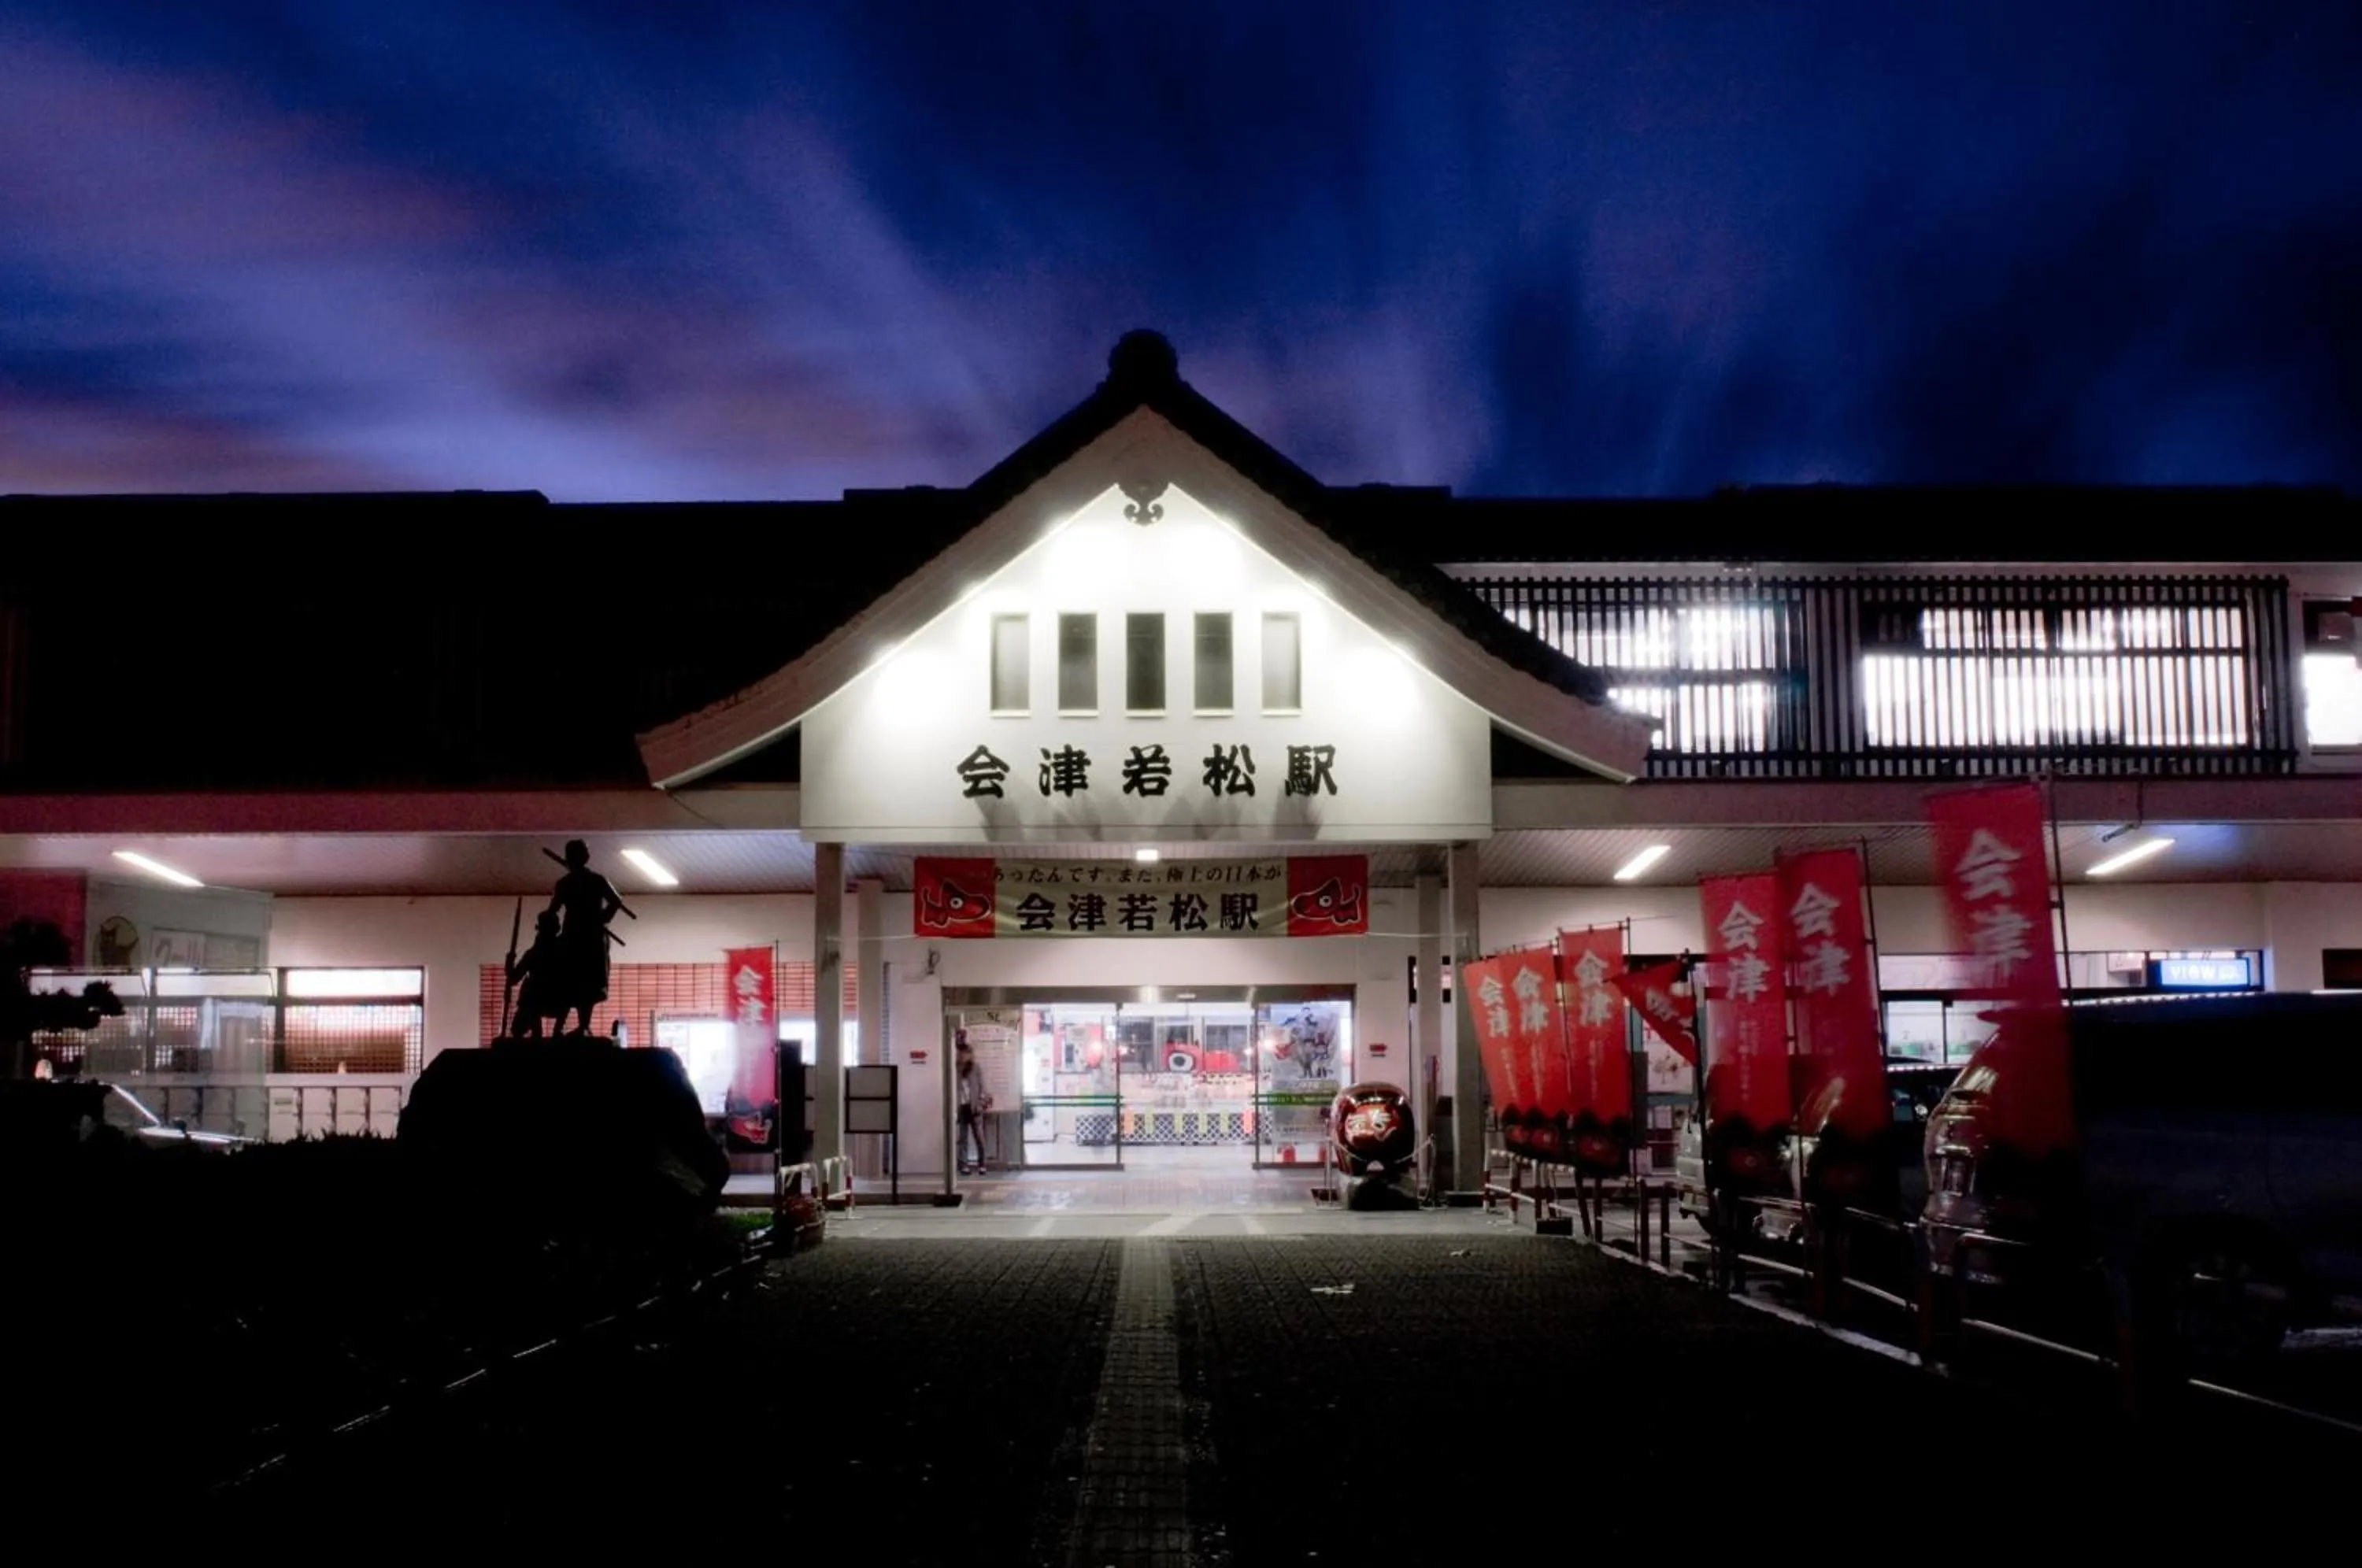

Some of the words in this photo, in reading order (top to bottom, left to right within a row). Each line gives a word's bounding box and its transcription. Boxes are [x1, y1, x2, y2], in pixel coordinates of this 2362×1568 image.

[957, 745, 1338, 797] 会津若松駅
[1016, 893, 1259, 931] 会津若松駅
[1791, 882, 1850, 997] 会津
[1953, 829, 2033, 978] 会津
[1575, 948, 1612, 1027] 会津
[1717, 900, 1771, 1004] 会津
[1512, 964, 1549, 1037] 会津
